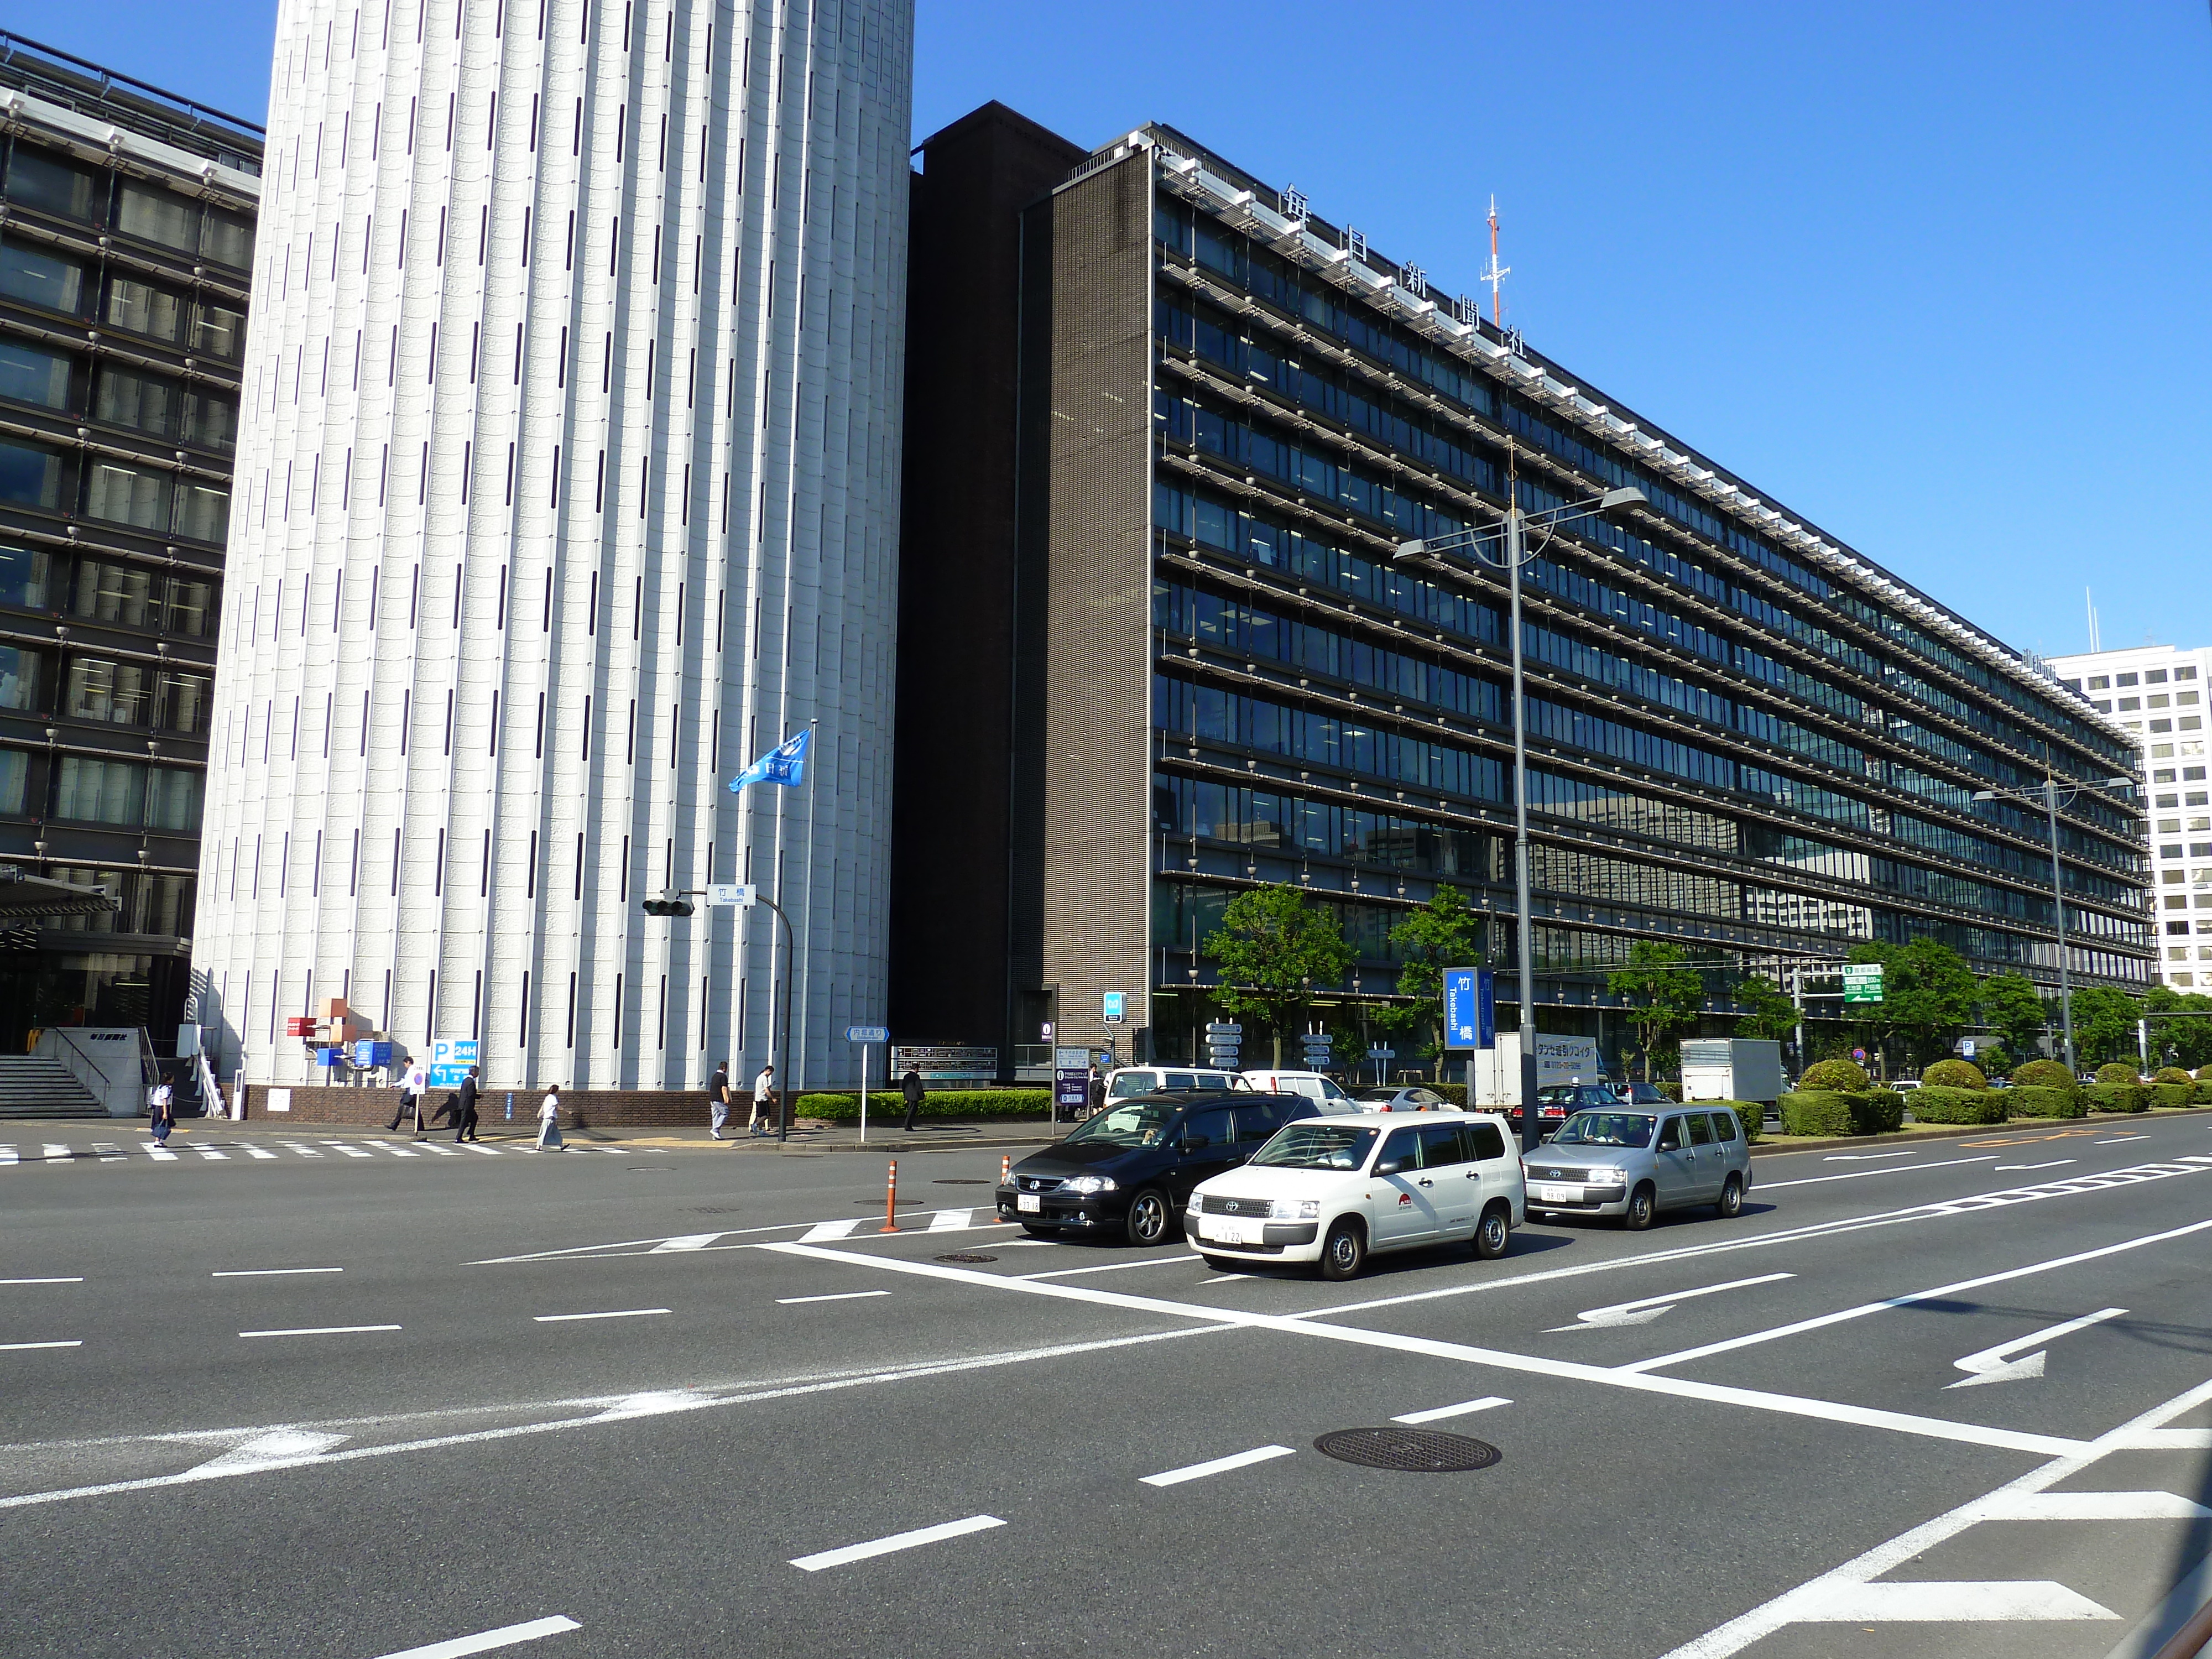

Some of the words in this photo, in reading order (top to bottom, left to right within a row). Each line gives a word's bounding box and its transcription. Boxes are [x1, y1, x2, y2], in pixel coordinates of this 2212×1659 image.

[1284, 182, 1527, 359] 毎日新聞社
[718, 888, 745, 896] 竹橋
[1449, 987, 1458, 1031] Takebashi
[1458, 977, 1473, 1040] 竹橋
[435, 1043, 449, 1061] P
[454, 1046, 476, 1056] 24H
